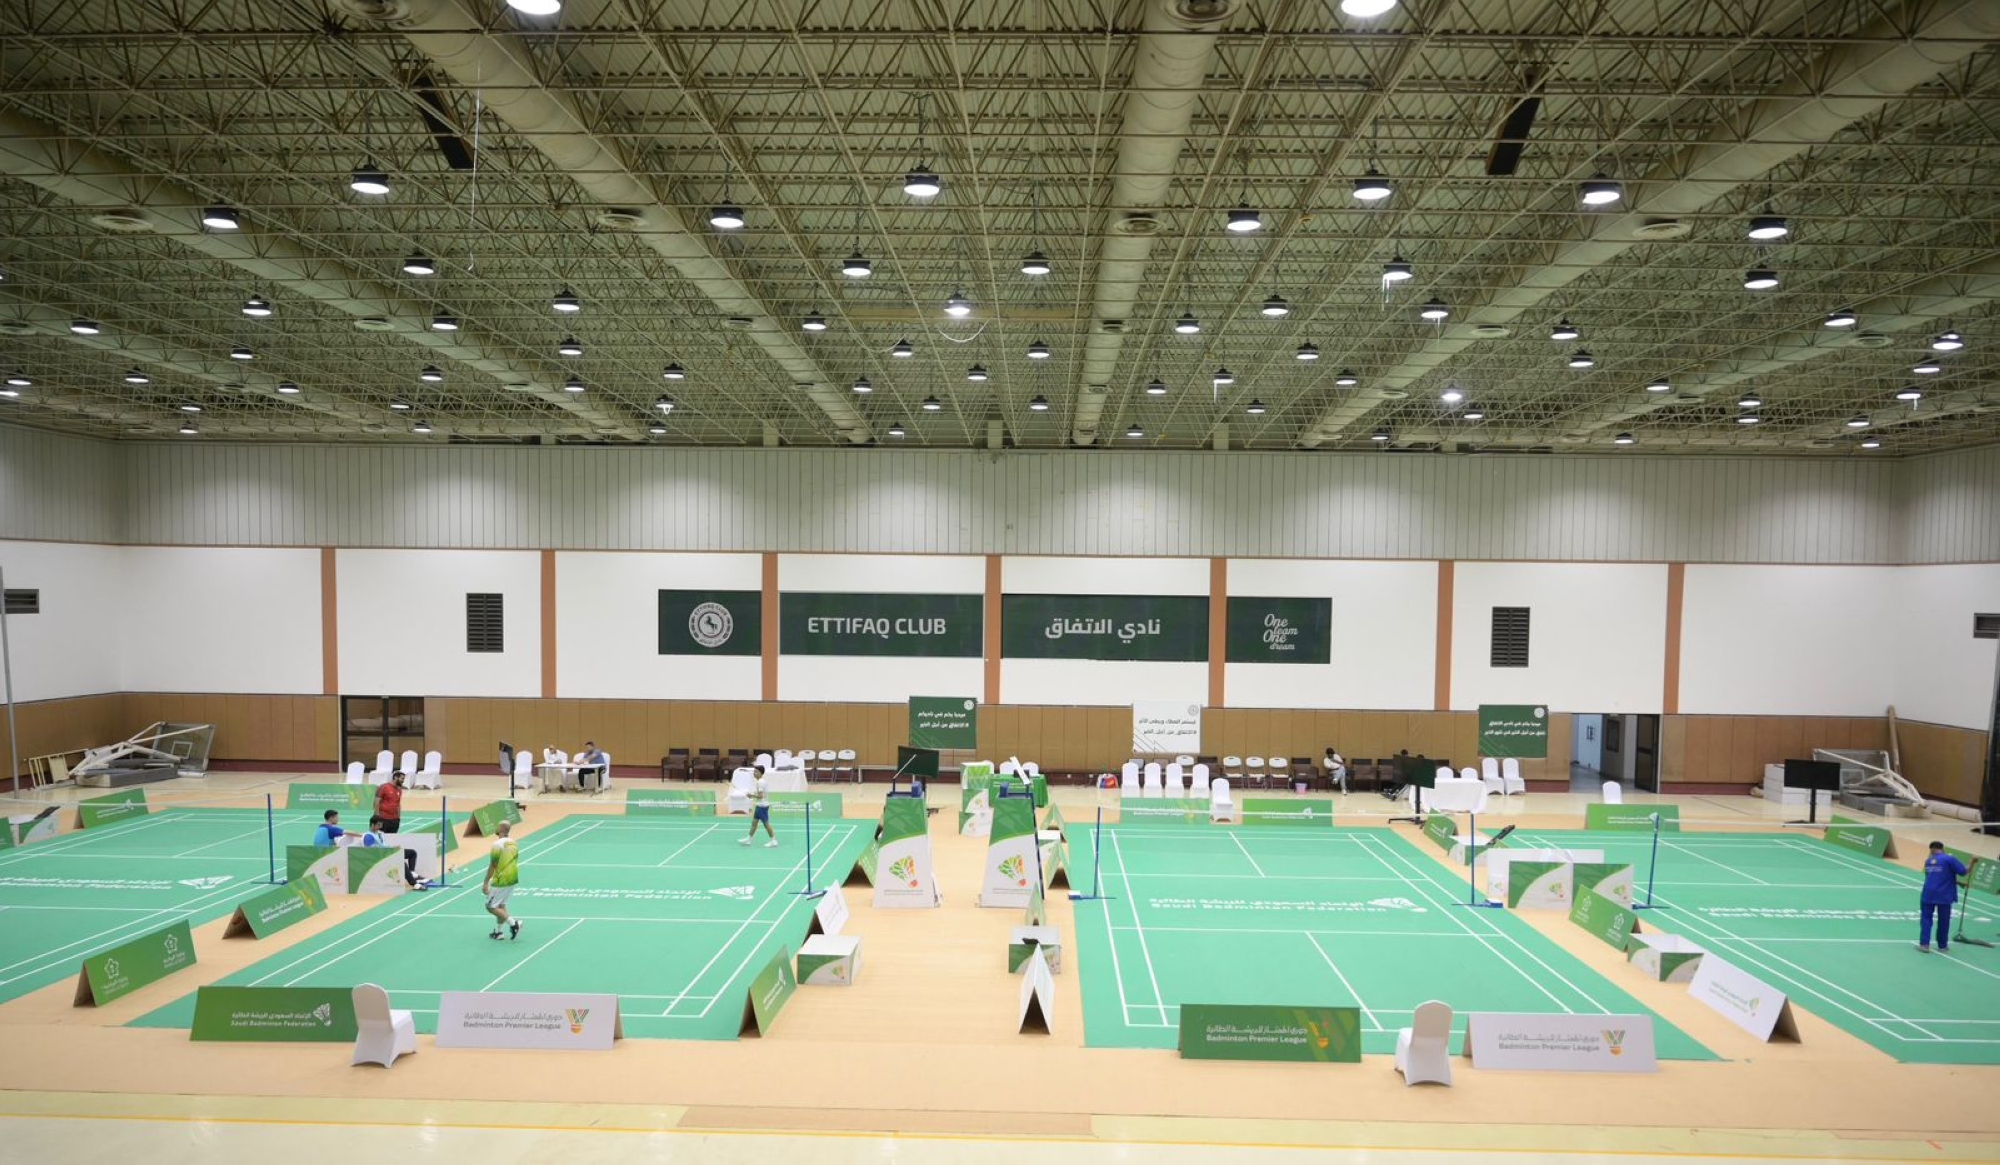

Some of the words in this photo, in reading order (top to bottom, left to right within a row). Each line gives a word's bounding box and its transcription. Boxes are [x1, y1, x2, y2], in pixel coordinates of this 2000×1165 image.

[1264, 613, 1289, 627] One
[808, 617, 890, 639] ETTIFAQ
[895, 618, 947, 635] CLUB
[1045, 618, 1113, 639] الاتفاق
[1118, 619, 1161, 644] نادي
[1263, 629, 1288, 644] One
[230, 1019, 248, 1028] Saudi
[249, 1019, 282, 1028] Badminton
[283, 1019, 316, 1028] Federation
[463, 1021, 504, 1031] Badminton
[504, 1021, 533, 1031] Premier
[534, 1021, 561, 1031] League
[1205, 1034, 1248, 1045] Badminton
[1249, 1034, 1280, 1045] Premier
[1279, 1034, 1307, 1045] League
[1498, 1043, 1540, 1052] Badminton
[1541, 1043, 1572, 1052] Premier
[1572, 1043, 1600, 1052] League
